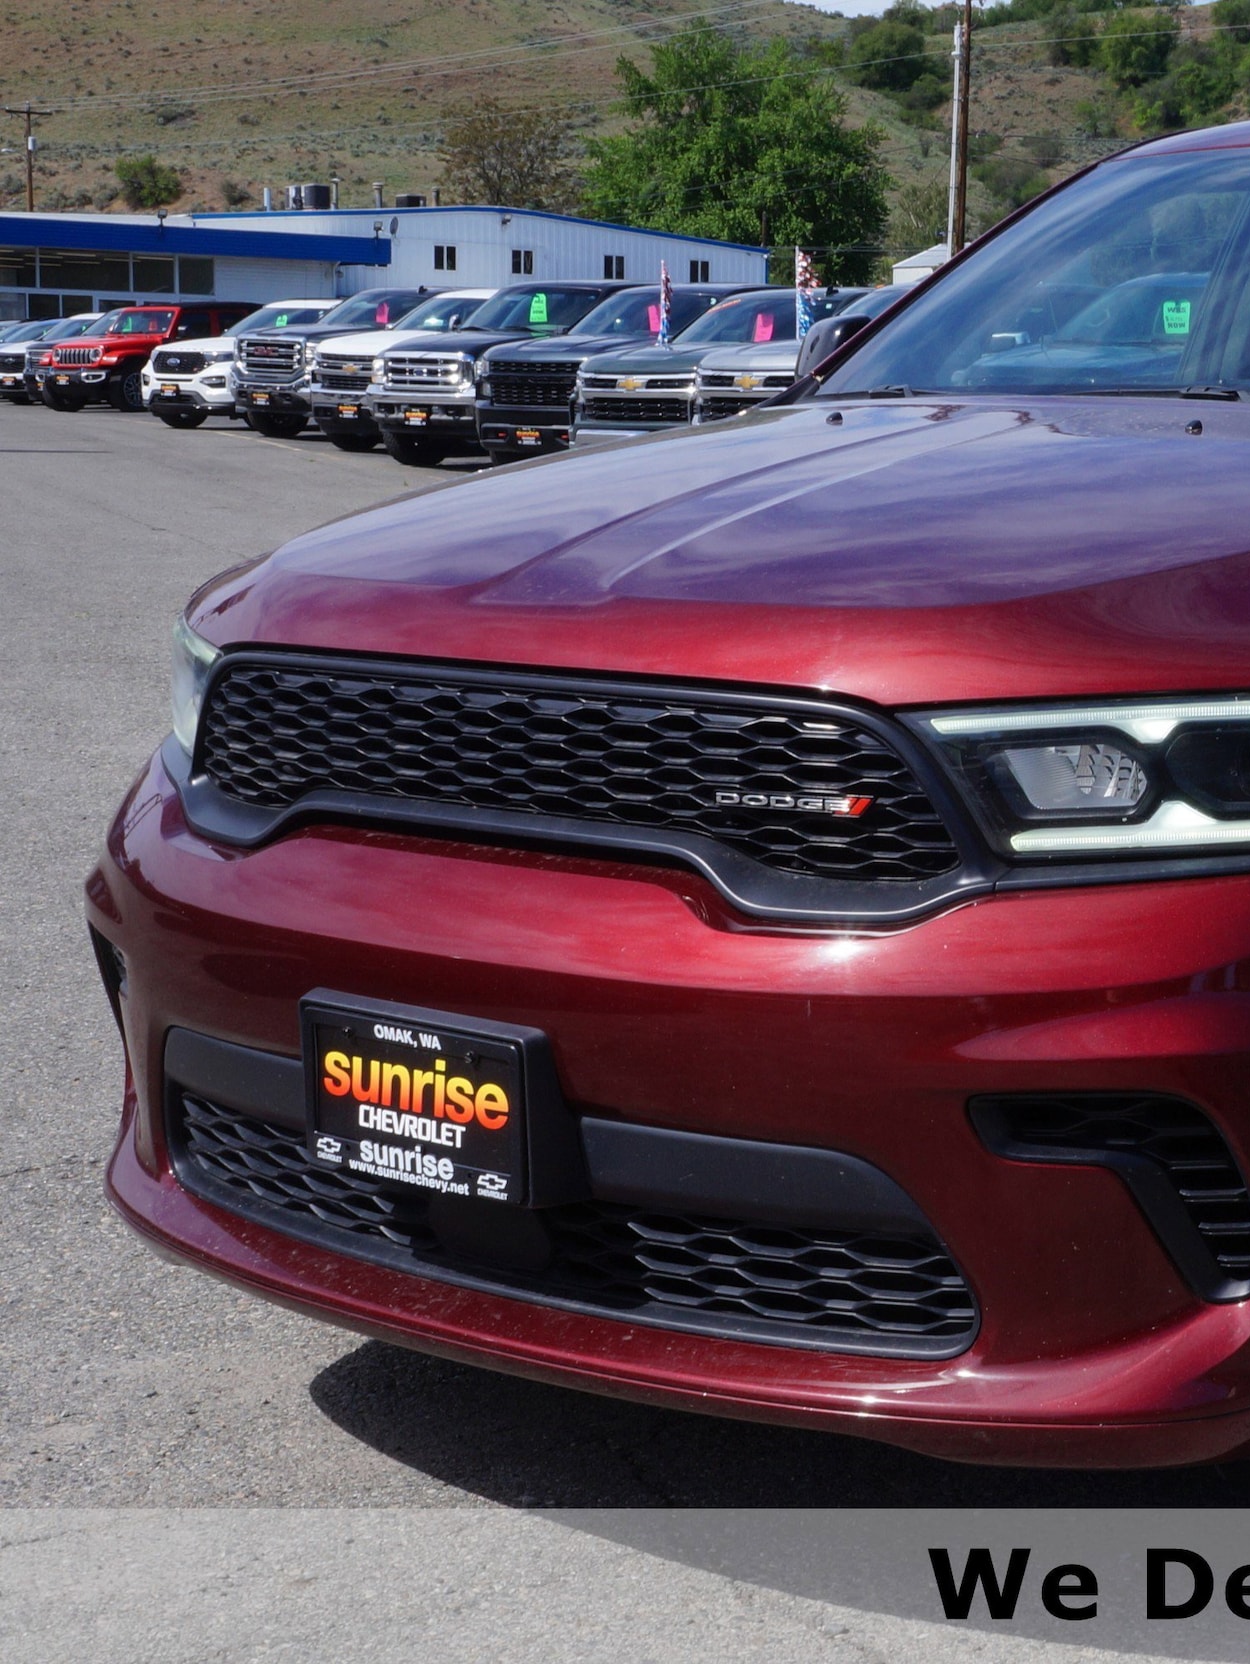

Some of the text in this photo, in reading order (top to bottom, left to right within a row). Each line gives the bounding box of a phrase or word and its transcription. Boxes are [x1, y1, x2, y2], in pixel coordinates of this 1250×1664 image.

[716, 792, 850, 813] DODGE
[374, 1024, 442, 1050] OMAK, WA
[324, 1051, 509, 1130] sunrise
[359, 1104, 466, 1148] CHEVROLET
[349, 1159, 469, 1196] www.sunrisechevy.net
[360, 1140, 454, 1180] sunrise
